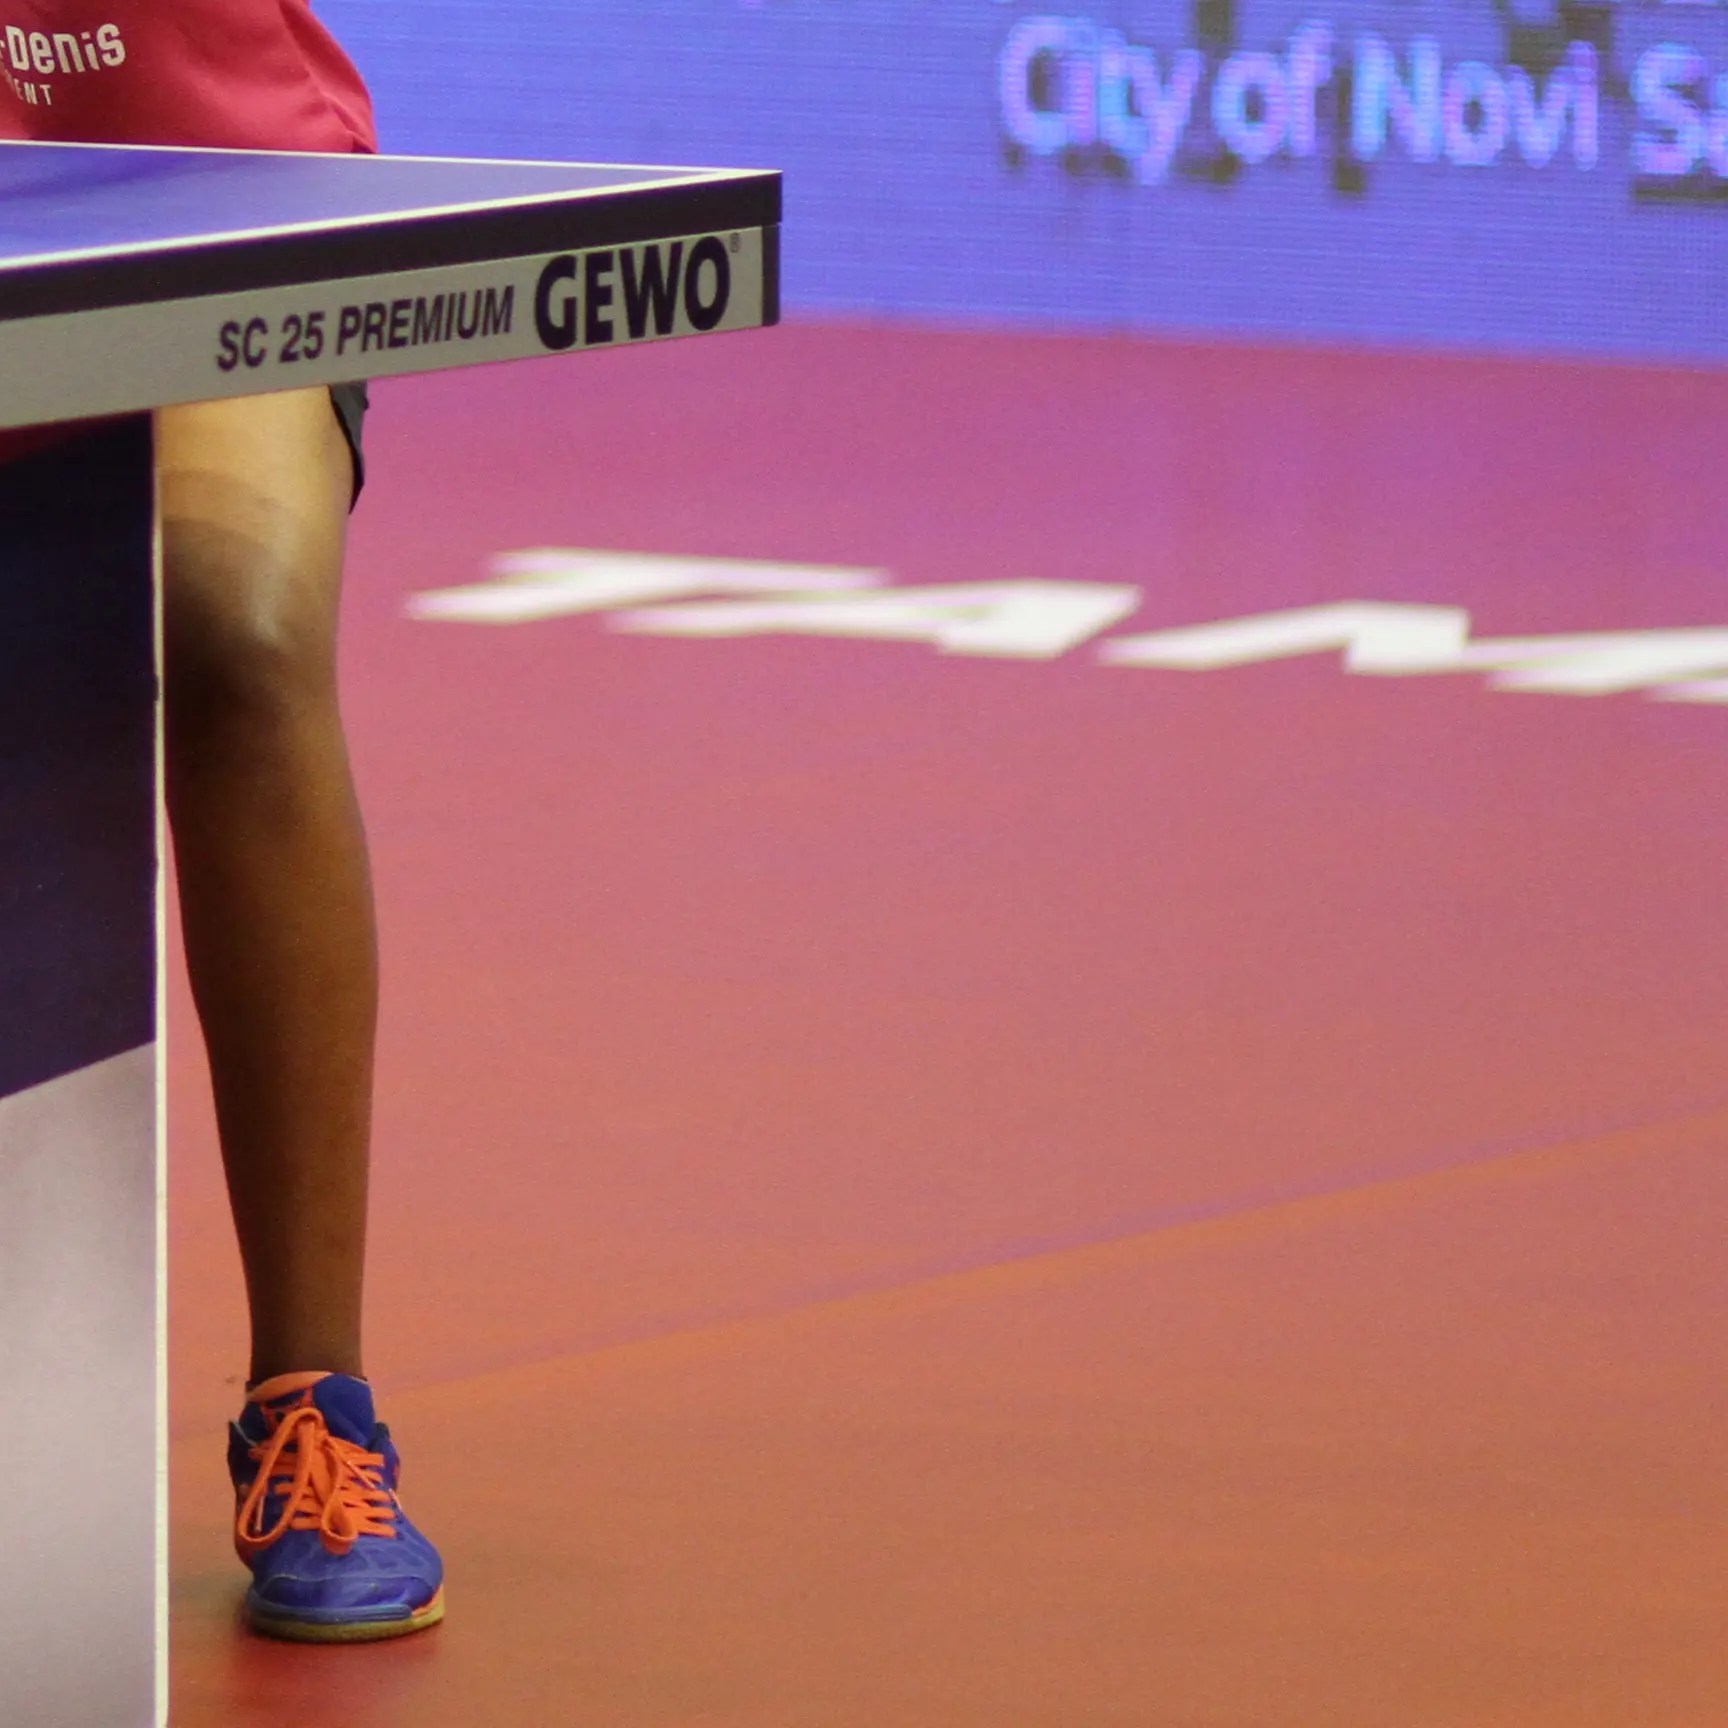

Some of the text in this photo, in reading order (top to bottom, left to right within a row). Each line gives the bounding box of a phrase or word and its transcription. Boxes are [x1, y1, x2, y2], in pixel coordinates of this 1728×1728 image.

[999, 14, 1205, 186] City
[1212, 18, 1334, 164] of
[1350, 30, 1599, 173] Novi
[216, 235, 732, 372] SC 25 PREMIUM GEWO
